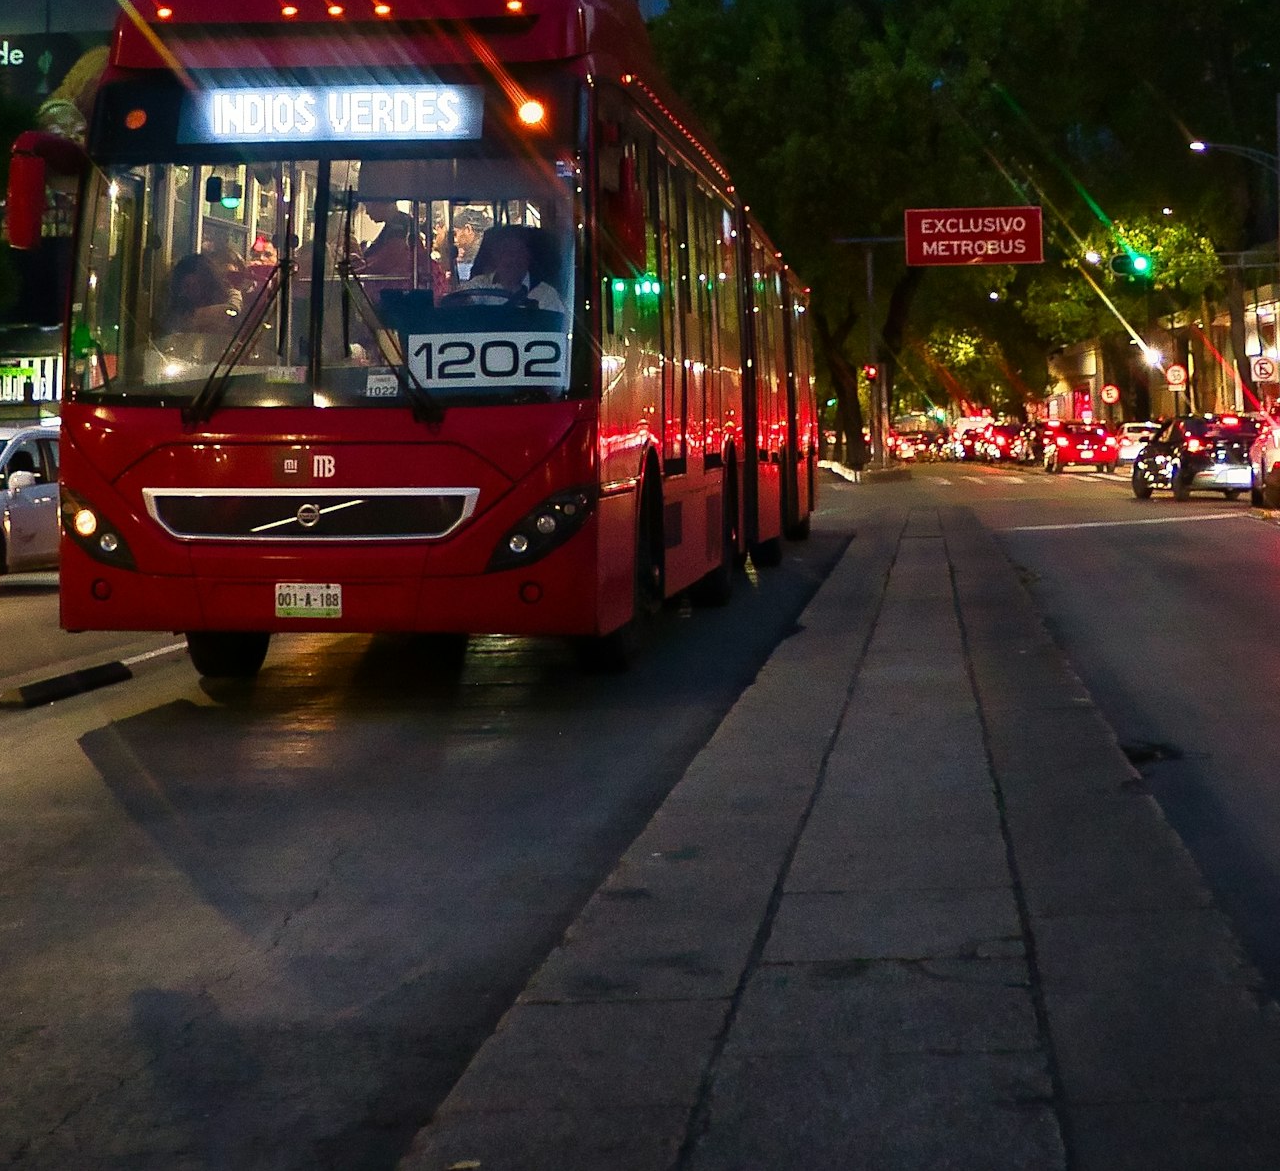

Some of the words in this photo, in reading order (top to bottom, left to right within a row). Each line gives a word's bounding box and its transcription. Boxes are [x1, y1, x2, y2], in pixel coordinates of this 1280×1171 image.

[214, 93, 317, 134] INDIOS
[328, 91, 460, 133] VERDES
[921, 216, 1026, 234] EXCLUSIVO
[922, 238, 1027, 256] METROBUS
[413, 340, 562, 380] 1202
